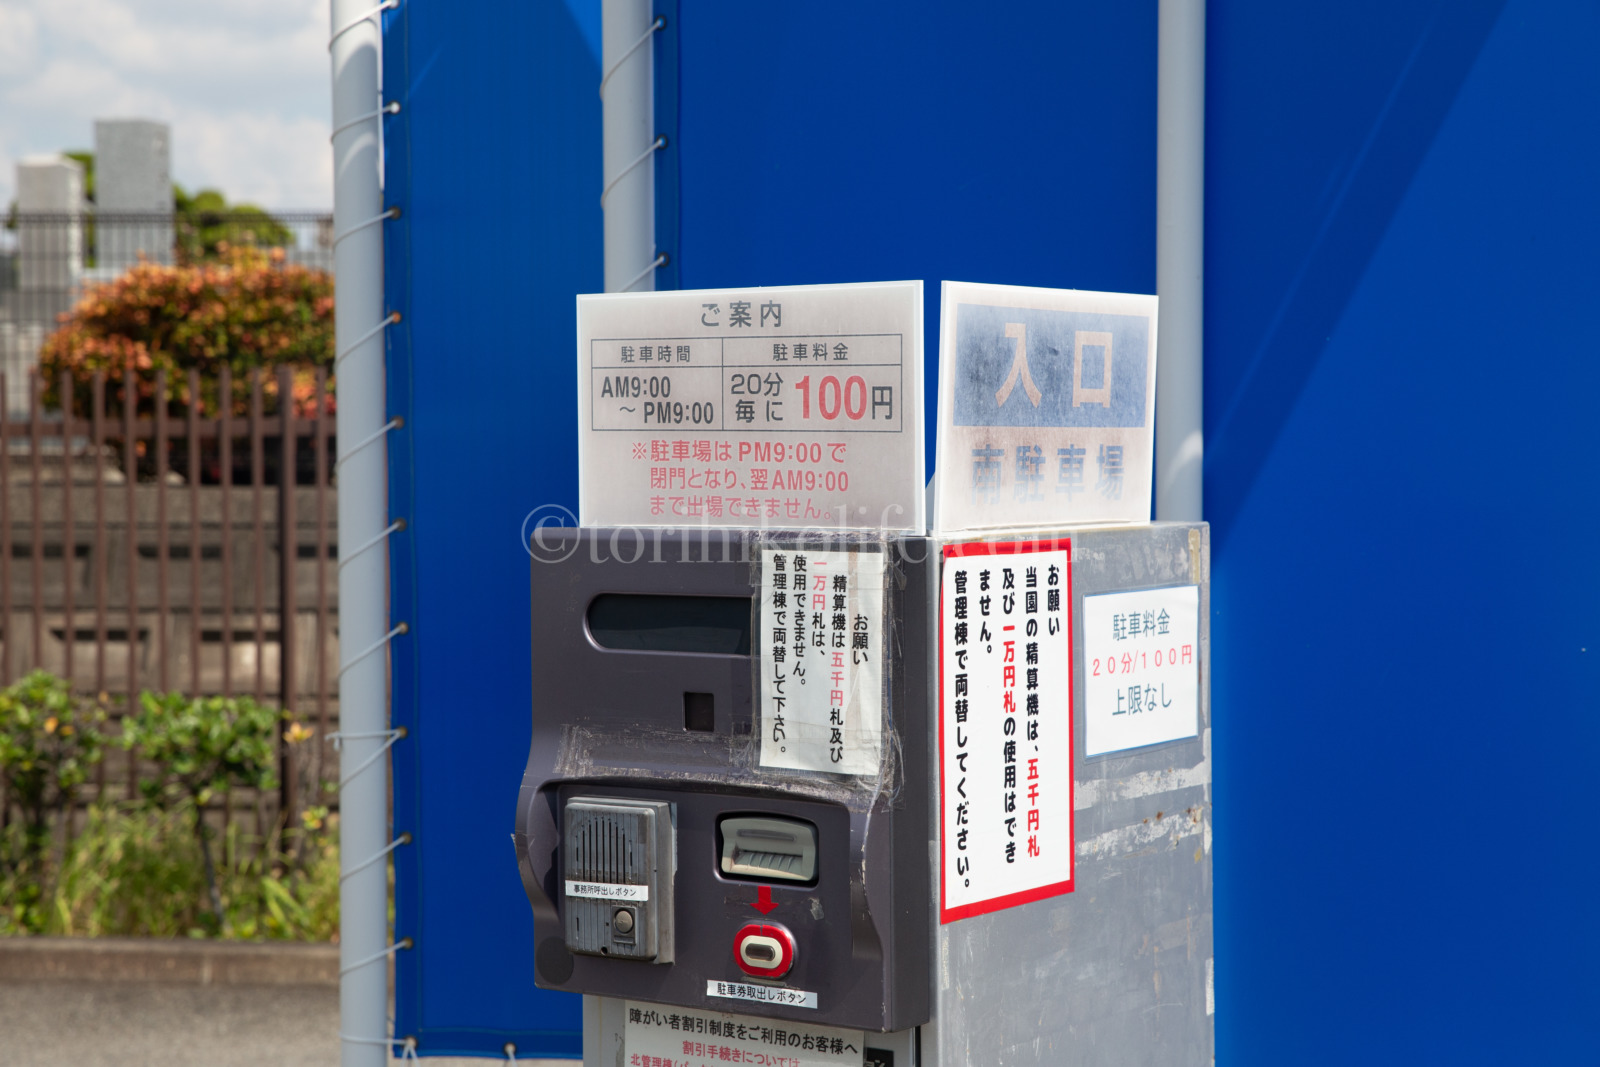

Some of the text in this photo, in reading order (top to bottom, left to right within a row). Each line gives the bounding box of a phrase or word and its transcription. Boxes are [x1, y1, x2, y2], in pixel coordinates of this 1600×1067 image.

[700, 300, 783, 328] ご案内
[620, 345, 691, 363] 駐車時間
[772, 343, 849, 361] 駐車料金
[995, 322, 1113, 408] 入口
[601, 376, 671, 398] AM9:00
[971, 443, 1124, 505] 南駐車場
[649, 495, 831, 520] まで出場できません。
[793, 554, 807, 686] 使用できません。
[979, 569, 992, 655] ません。
[1047, 564, 1061, 636] お願い
[852, 613, 869, 665] お願い
[1112, 608, 1170, 641] 駐車料金
[772, 553, 787, 753] 管理棟で両替して下さい。
[1112, 682, 1172, 716] 上限なし
[954, 570, 970, 888] 管理棟で両替してください。
[574, 884, 636, 897] 事務所呼出しボタン
[717, 982, 806, 1004] 駐車券取出しボタン
[629, 1008, 858, 1055] 障がい者割引制度をご利用のお客様へ
